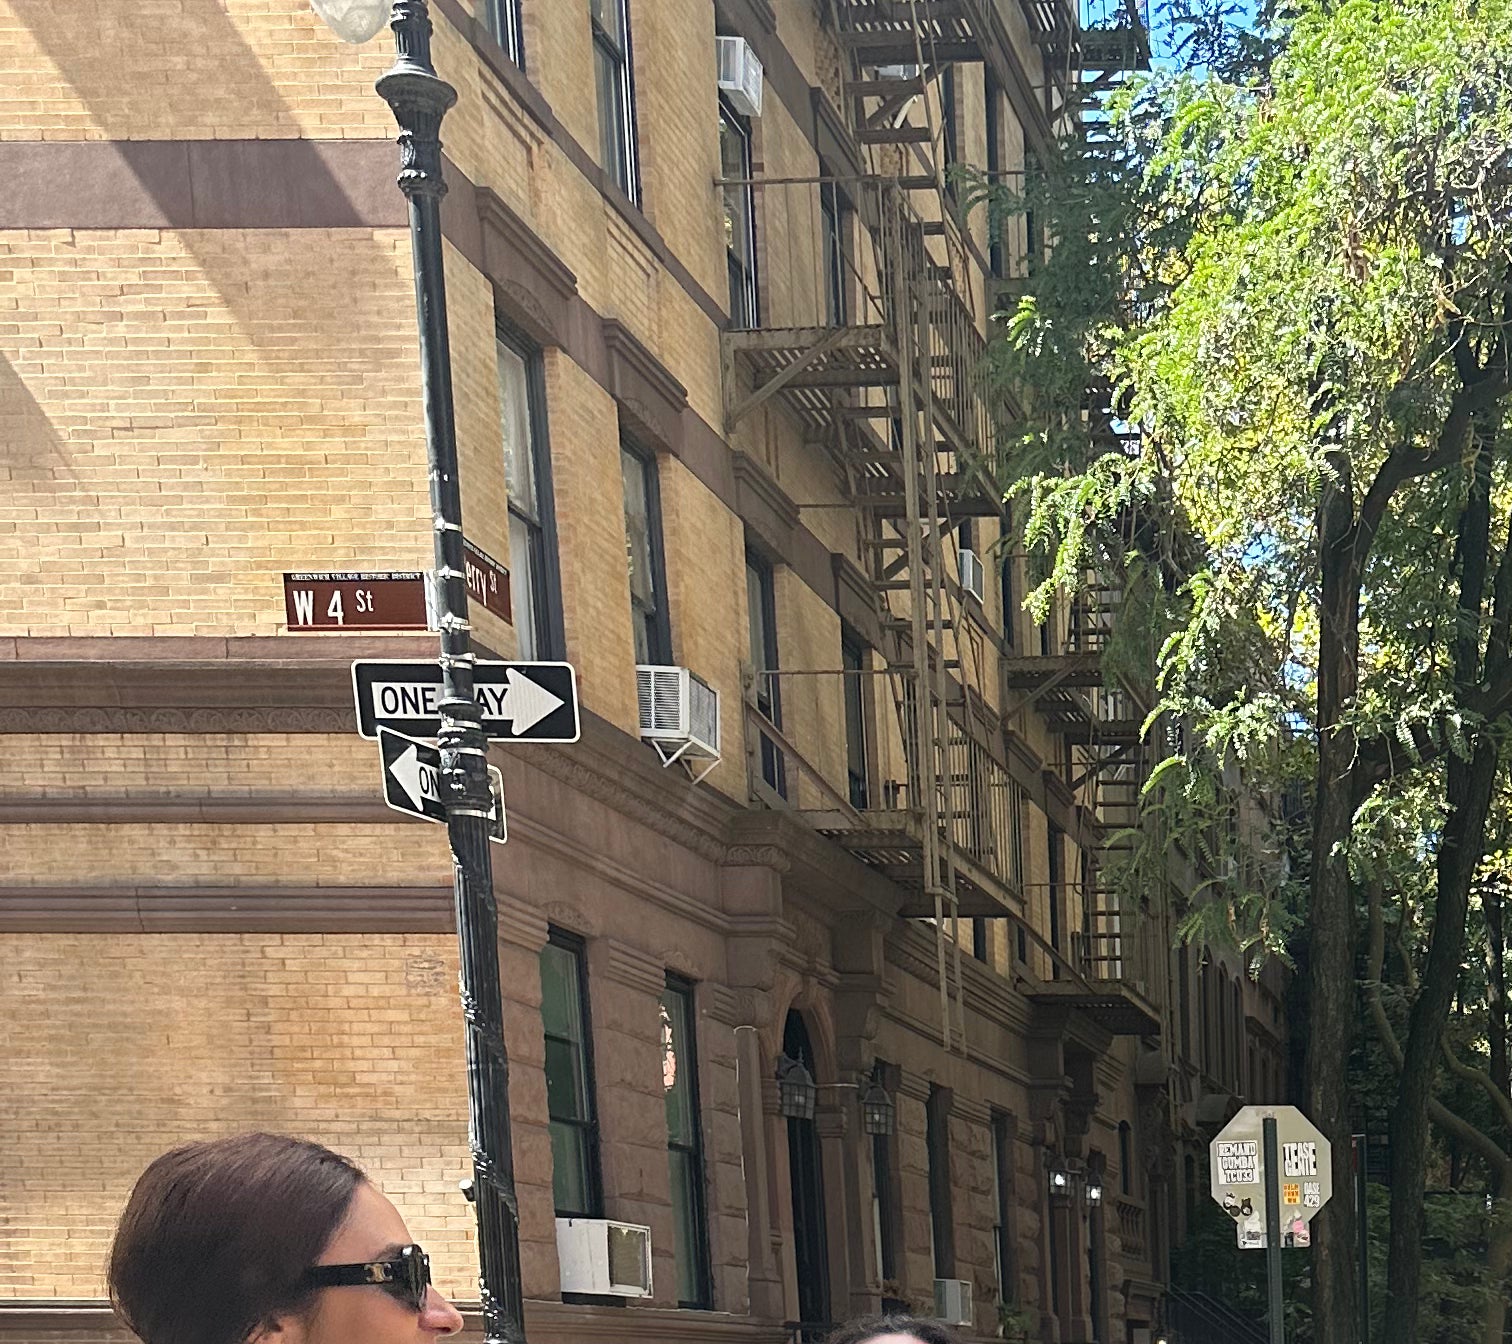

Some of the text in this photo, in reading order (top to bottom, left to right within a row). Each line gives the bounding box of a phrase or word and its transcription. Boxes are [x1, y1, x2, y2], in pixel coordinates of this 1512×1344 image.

[465, 560, 498, 607] erry St
[293, 589, 374, 625] W 4 St
[381, 686, 508, 716] ONE AY
